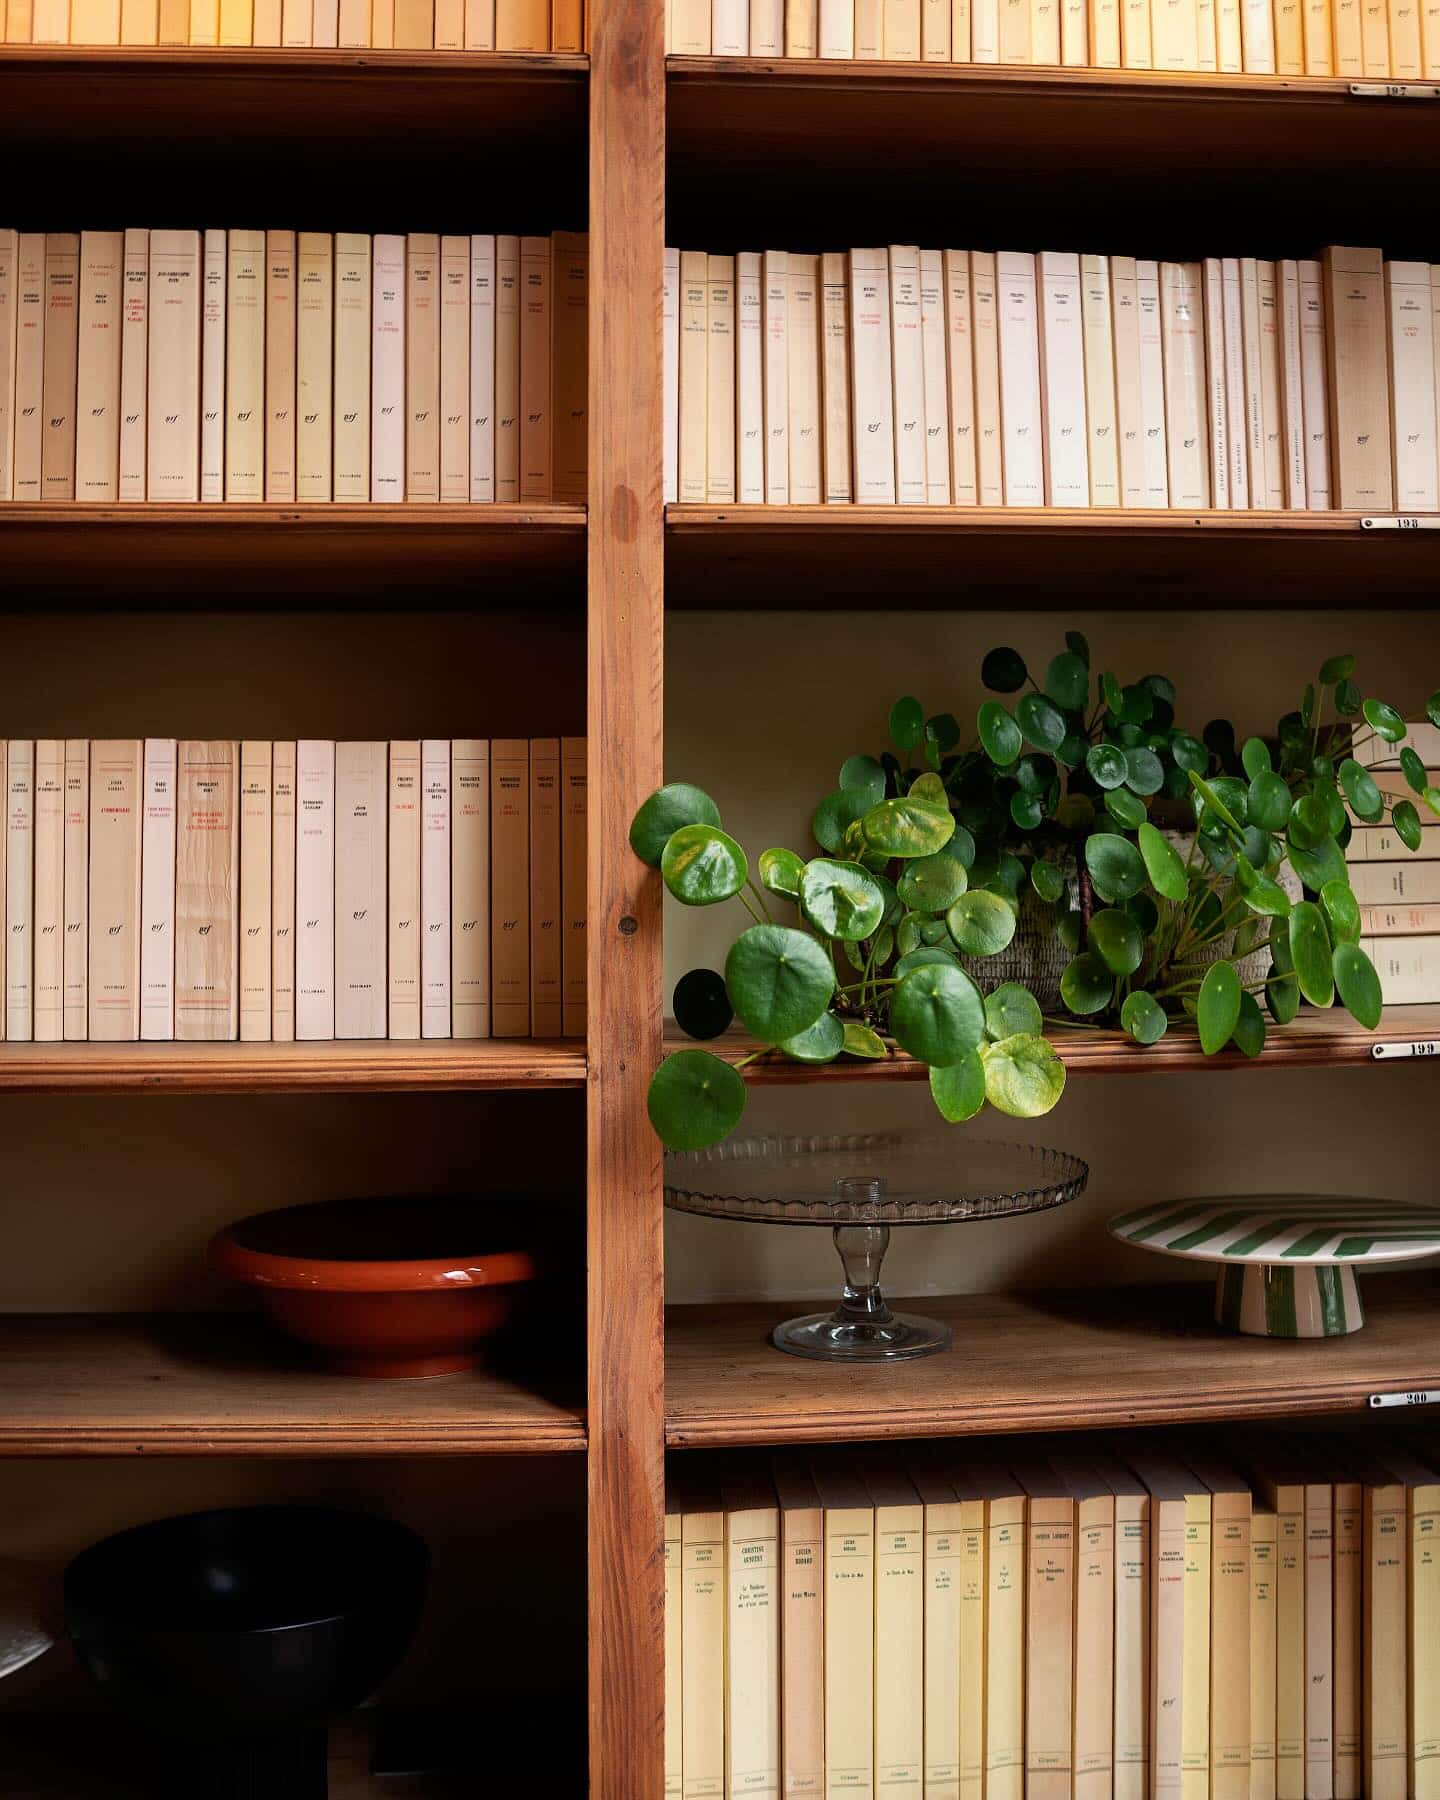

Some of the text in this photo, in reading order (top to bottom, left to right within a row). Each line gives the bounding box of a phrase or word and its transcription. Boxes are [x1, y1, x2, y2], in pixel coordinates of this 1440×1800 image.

[238, 411, 251, 421] nrf
[305, 414, 318, 423] nrf
[344, 413, 358, 422] nrf
[1397, 519, 1418, 528] 198
[353, 910, 367, 920] nrf
[13, 924, 24, 933] nrf
[68, 923, 80, 932] nrf
[399, 920, 411, 928] nrf
[429, 923, 442, 932] nrf
[463, 921, 477, 930] nrf
[43, 925, 56, 934] nrf
[109, 925, 123, 935] nrf
[248, 927, 261, 936] nrf
[277, 928, 290, 936] nrf
[1411, 1043, 1434, 1055] 199
[1406, 1393, 1427, 1404] 200
[741, 1546, 764, 1554] CHRISTINE
